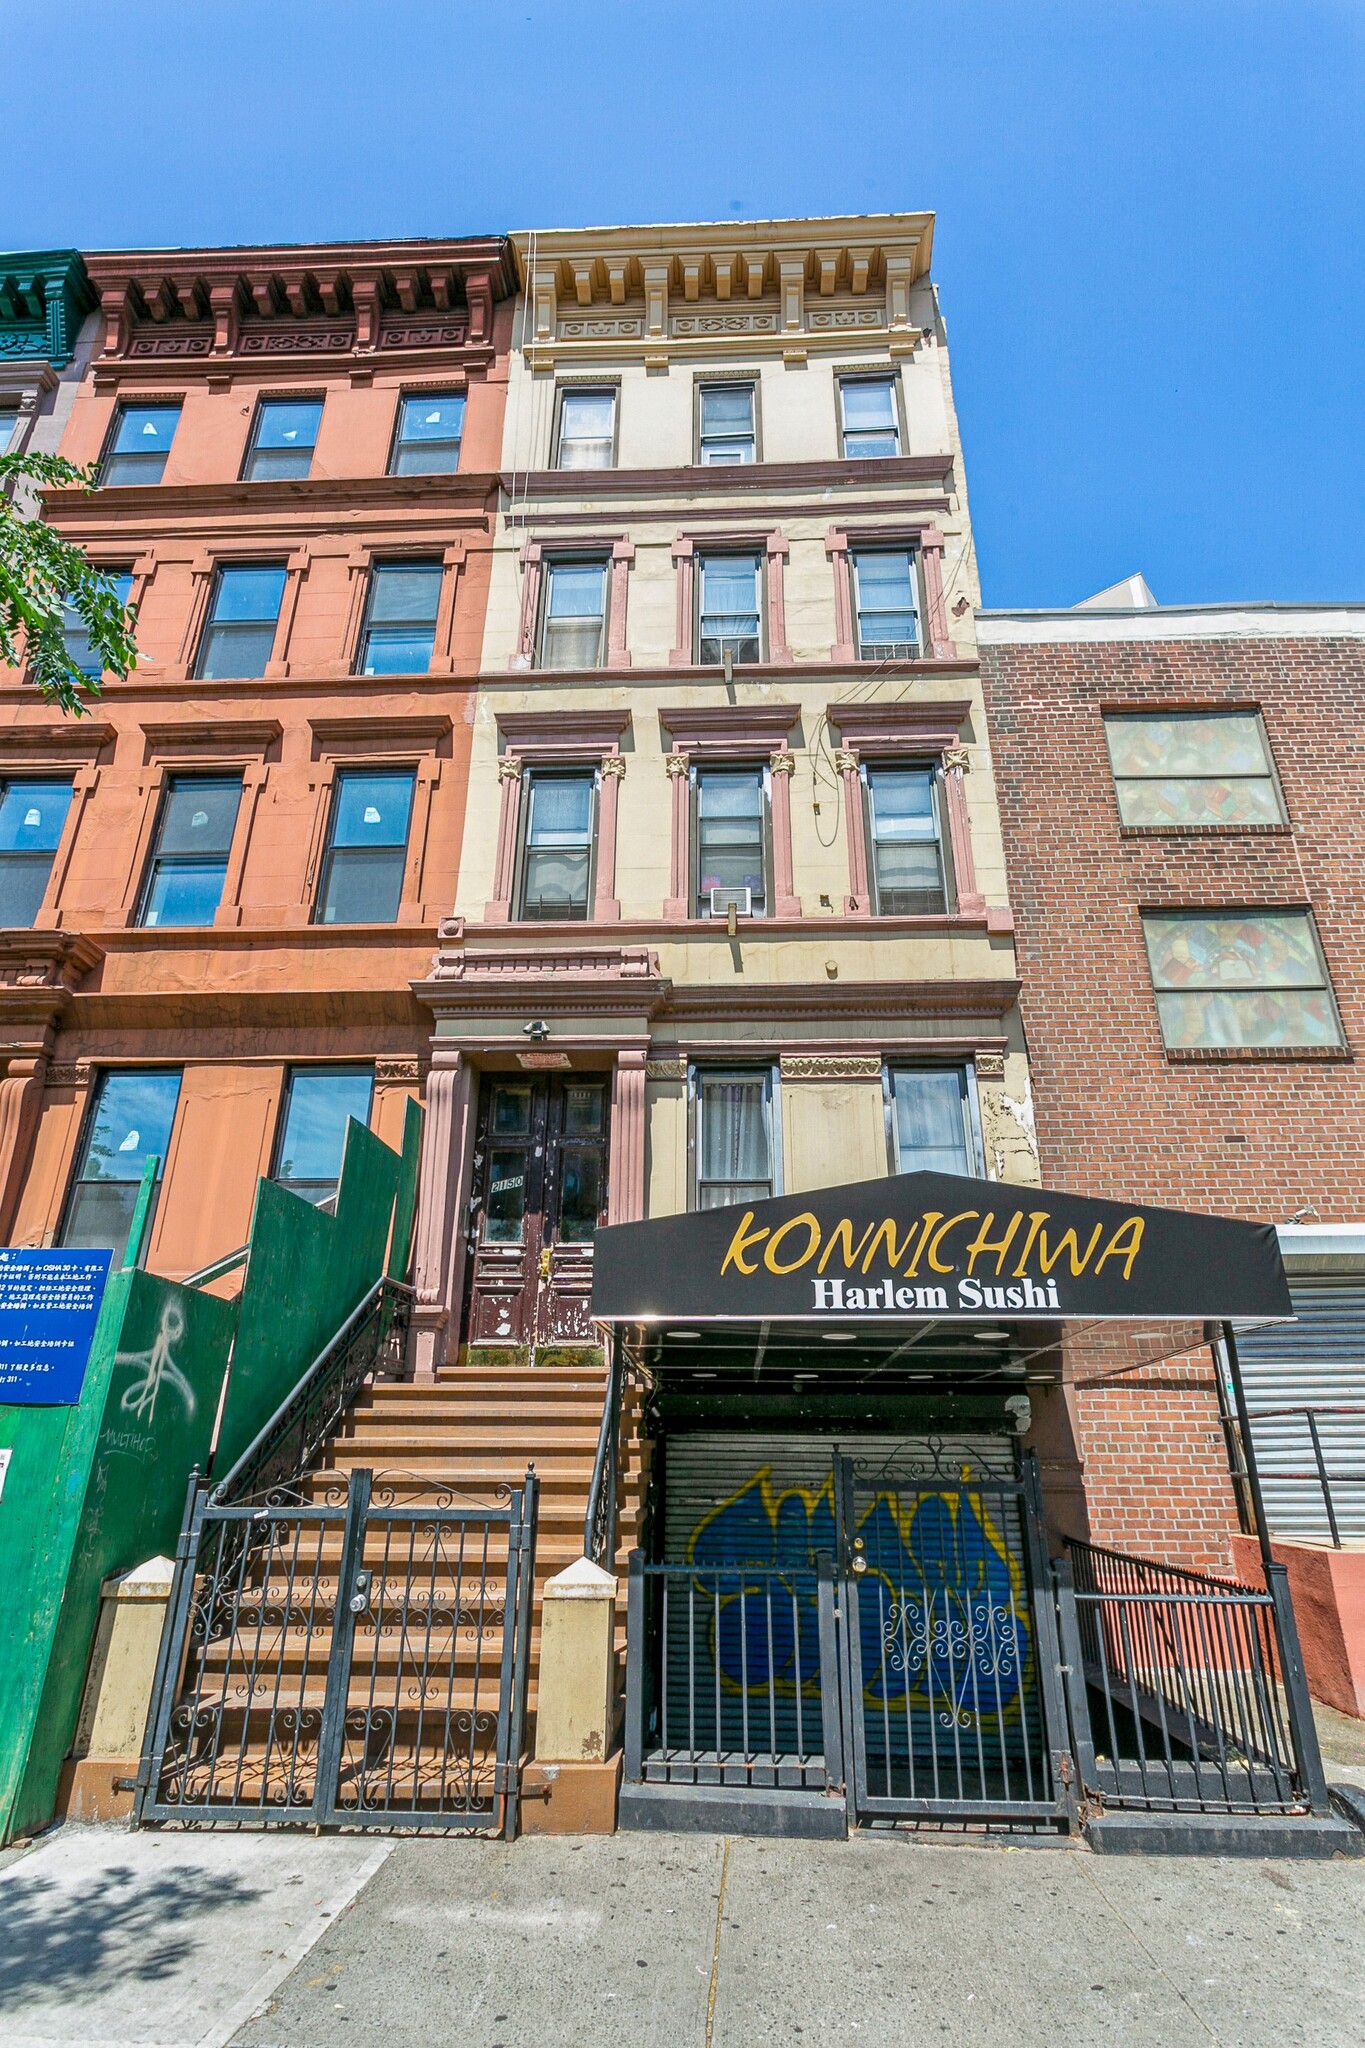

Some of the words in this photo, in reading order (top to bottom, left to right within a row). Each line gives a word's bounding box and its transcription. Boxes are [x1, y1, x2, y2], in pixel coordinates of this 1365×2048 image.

[492, 1176, 522, 1192] 2150
[720, 1209, 1146, 1280] KONNICHIWA
[43, 1264, 62, 1272] OSHA
[62, 1264, 71, 1272] 30
[812, 1278, 949, 1310] Harlem
[958, 1278, 1061, 1310] Sushi
